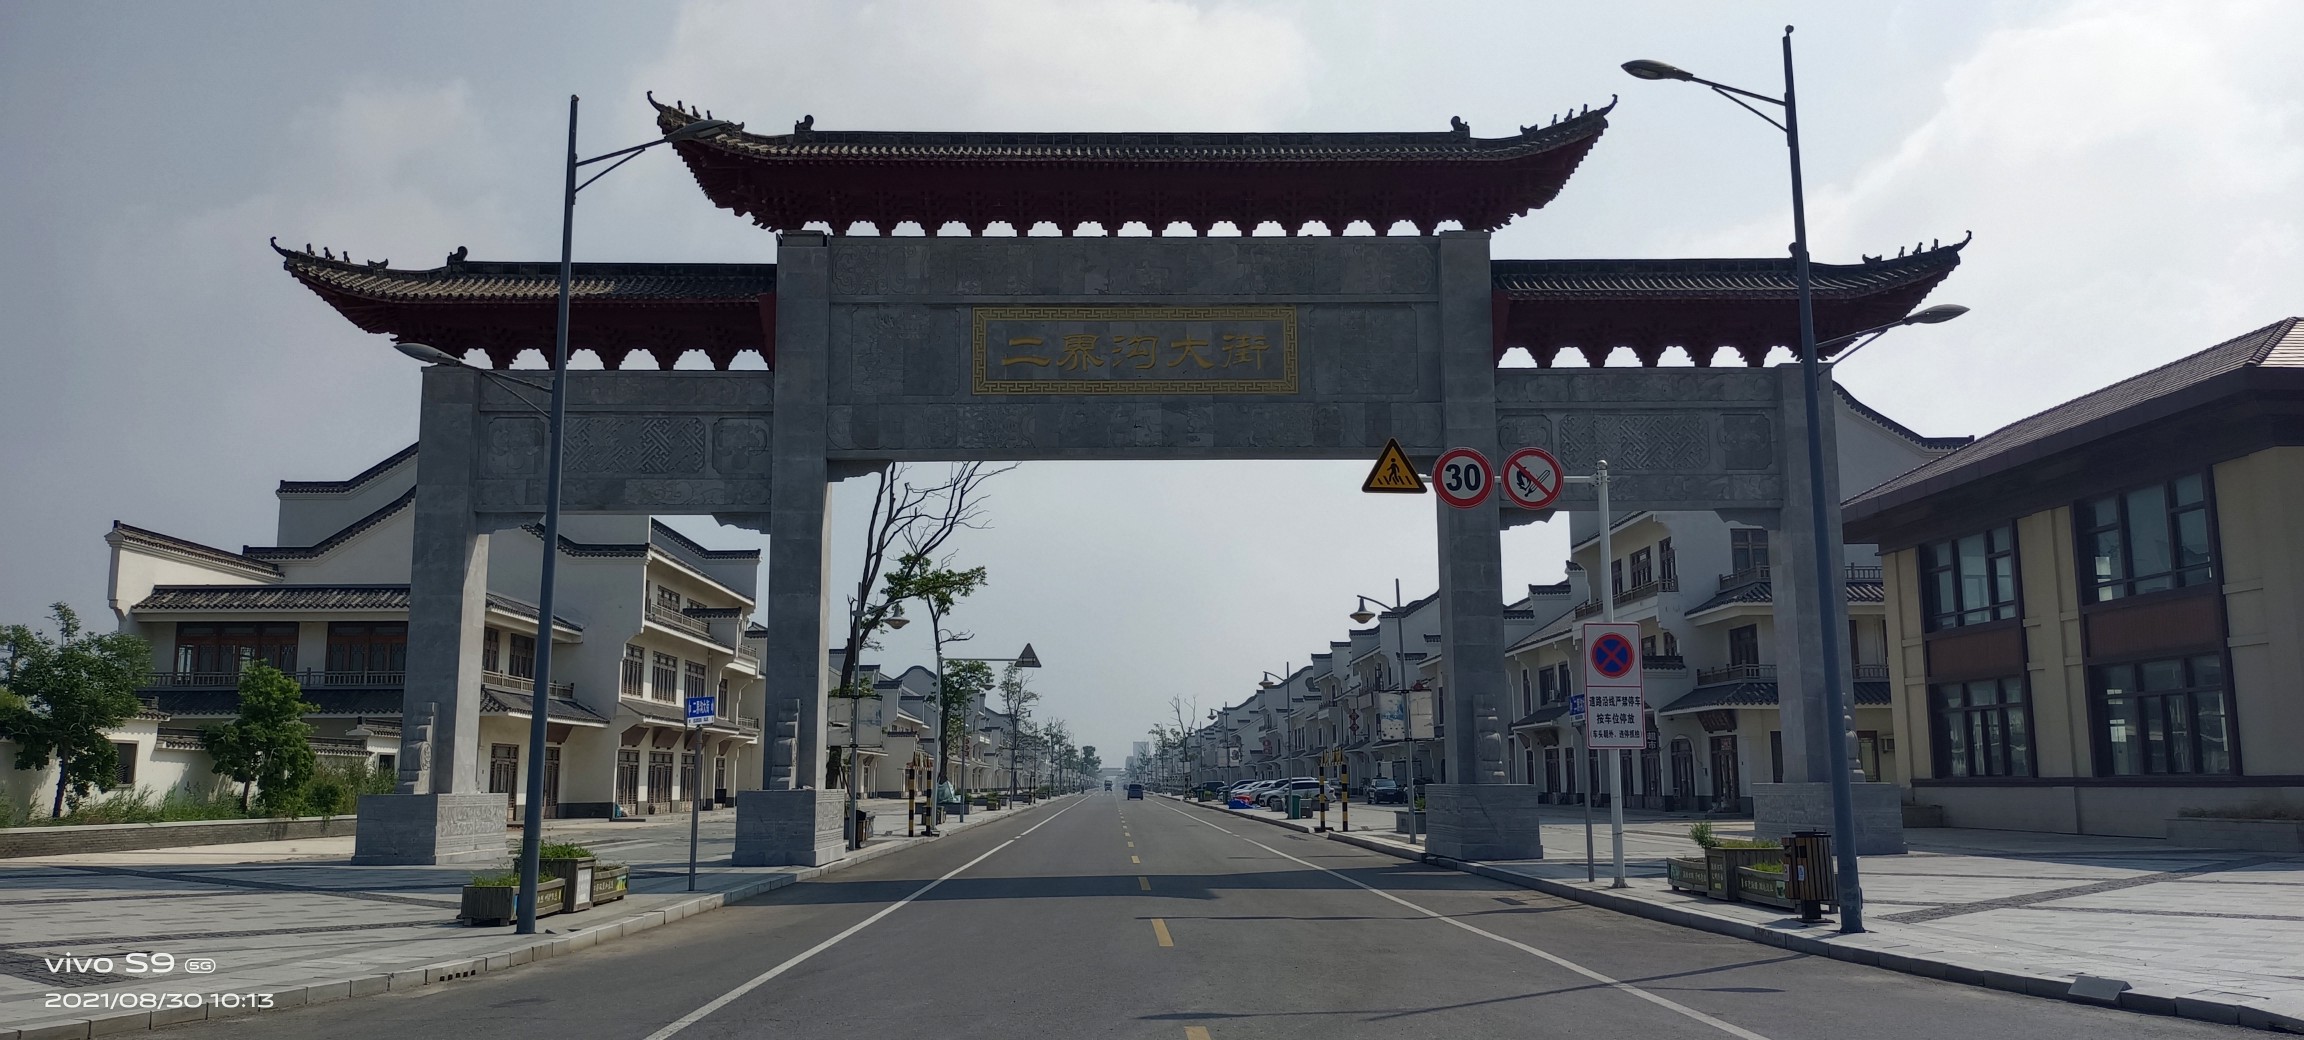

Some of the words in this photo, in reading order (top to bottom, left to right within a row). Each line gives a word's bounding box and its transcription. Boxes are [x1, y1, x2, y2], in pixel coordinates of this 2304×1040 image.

[1001, 333, 1270, 373] 二界沟大街
[1445, 463, 1481, 492] 30
[1589, 696, 1641, 707] 道路沿线严禁停车
[1596, 713, 1635, 724] 按车位停放
[1646, 731, 1657, 749] 超市
